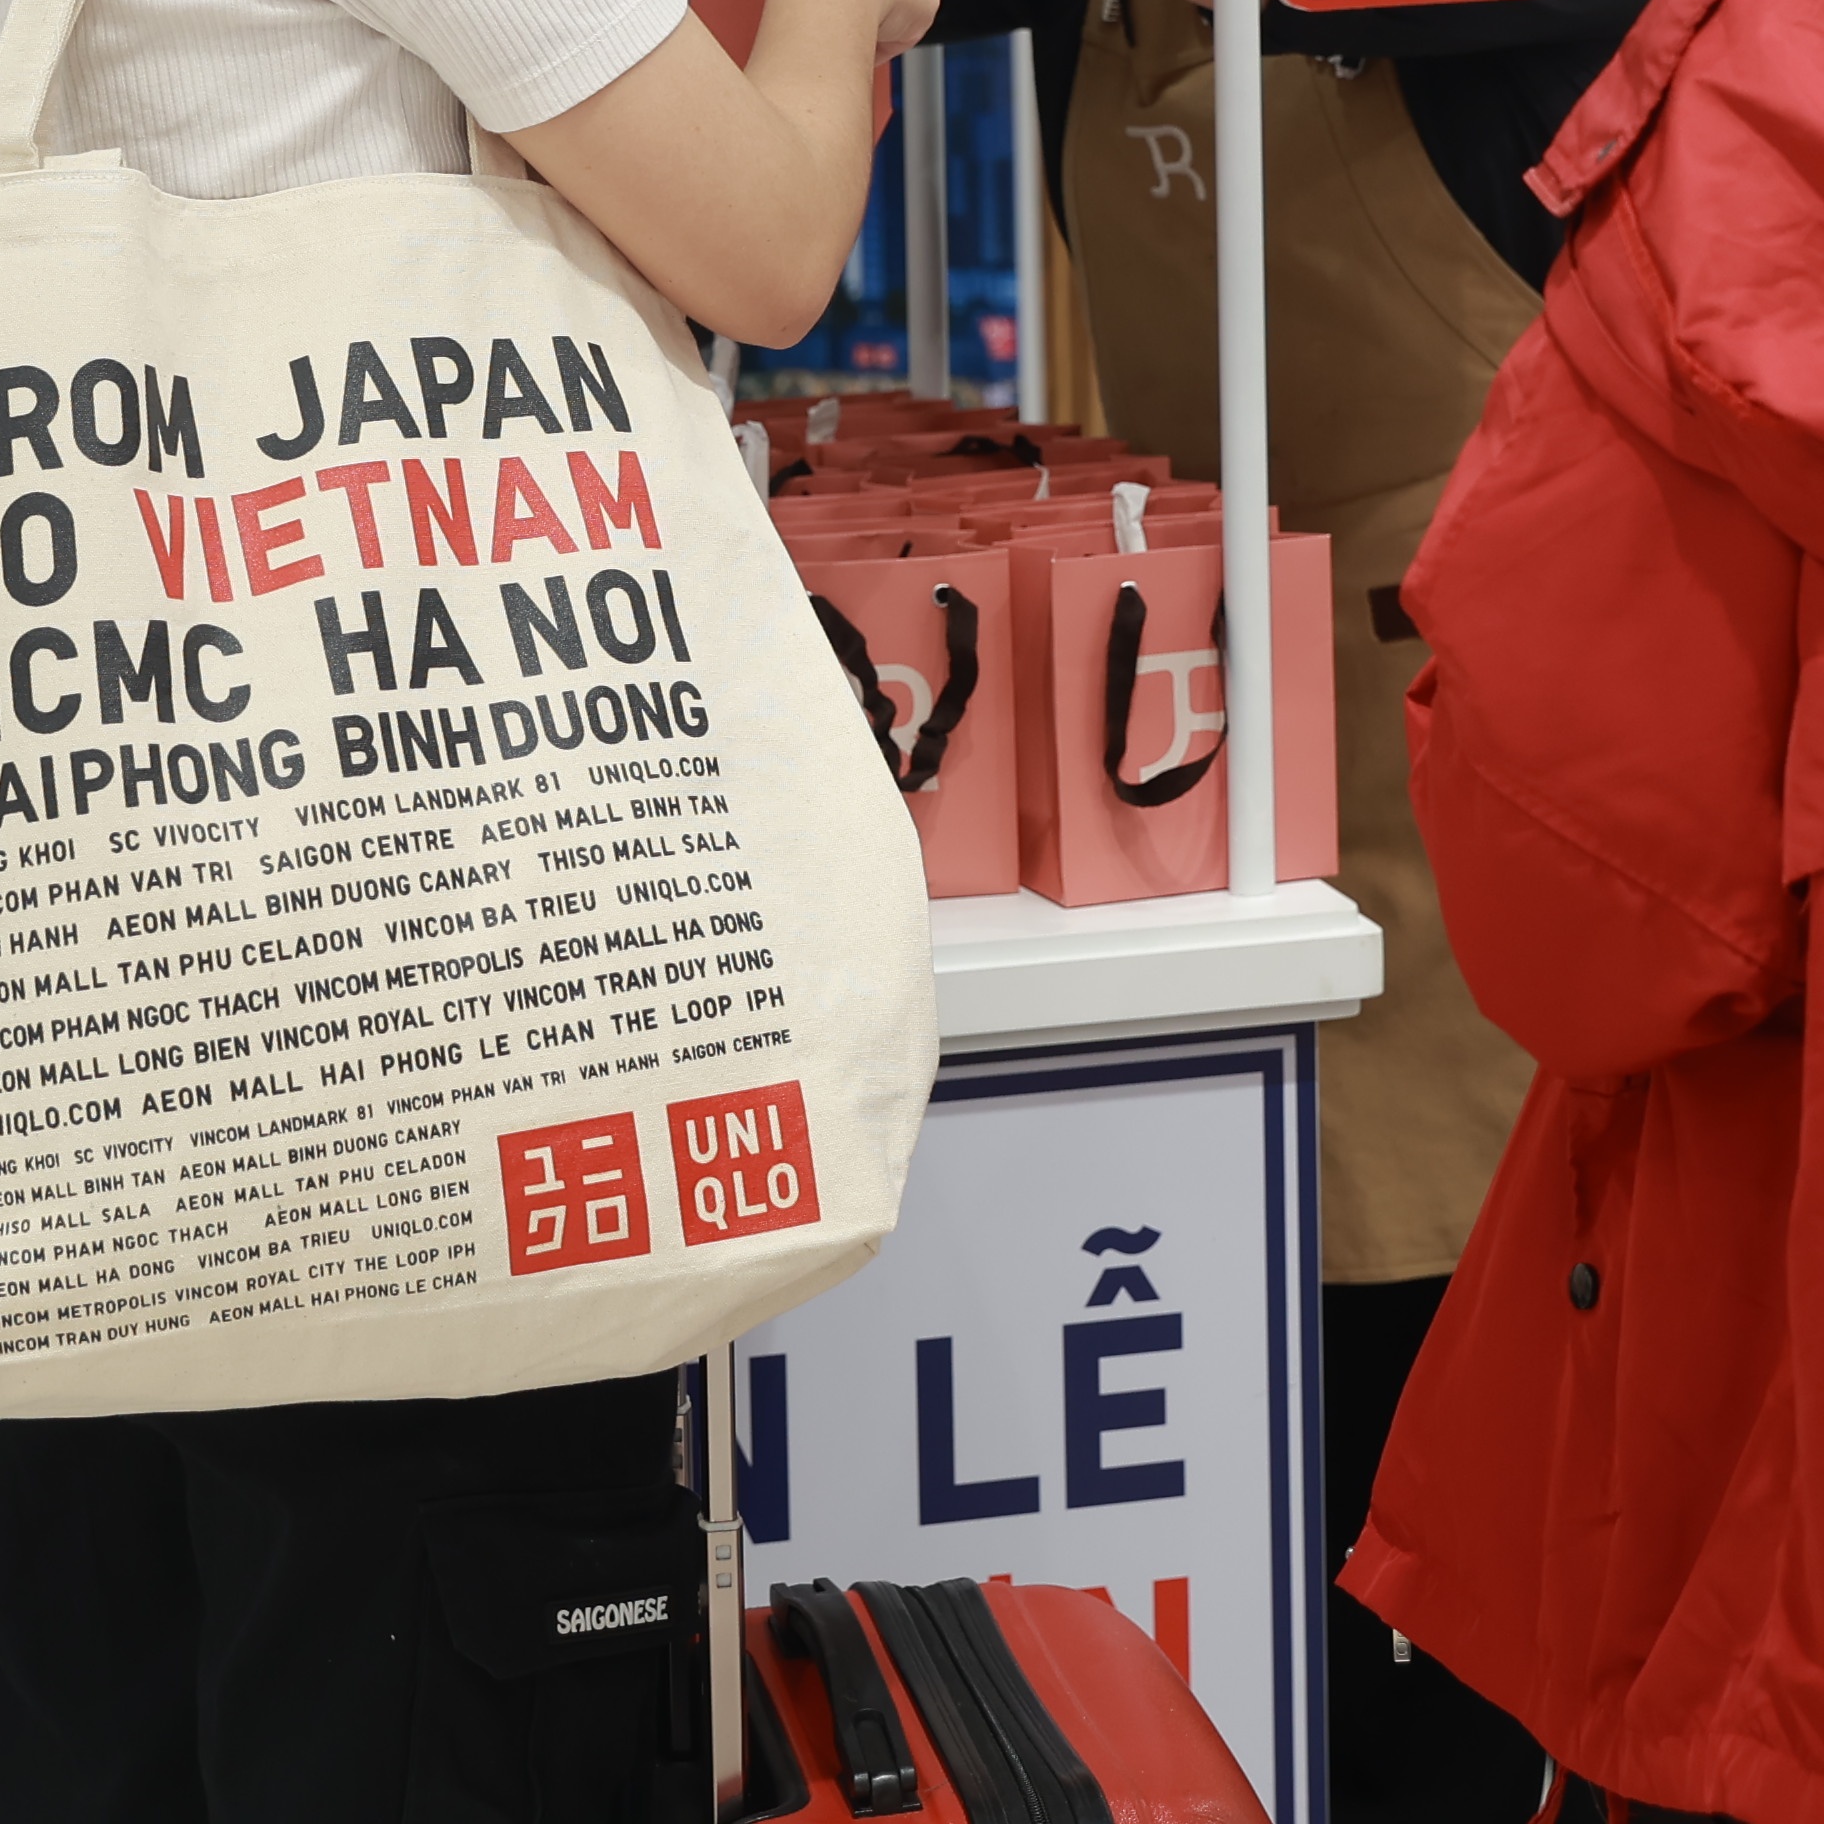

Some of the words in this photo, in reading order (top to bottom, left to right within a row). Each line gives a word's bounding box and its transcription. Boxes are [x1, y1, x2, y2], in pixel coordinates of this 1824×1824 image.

[255, 335, 632, 462] JAPAN
[132, 450, 663, 603] VIETNAM
[313, 587, 485, 696] HA
[499, 568, 692, 678] NOI
[331, 705, 487, 778] BINH
[488, 680, 710, 761] DUONG
[18, 838, 76, 869] KHOI
[108, 829, 141, 854] SC
[152, 816, 259, 848] VIVOCITY
[294, 794, 387, 827] VINCOM
[394, 777, 525, 814] LANDMARK
[534, 771, 561, 794] 81
[588, 756, 720, 786] UNIQLO.COM
[141, 1083, 212, 1116] AEON
[229, 1070, 304, 1102] MALL
[319, 1058, 365, 1087] HAI
[380, 1042, 463, 1077] PHONG
[479, 1033, 511, 1060] LE
[526, 1018, 595, 1051] CHAN
[609, 1007, 659, 1036] THE
[671, 994, 732, 1025] LOOP
[745, 985, 785, 1012] IPH
[685, 1104, 783, 1164] UNI
[694, 1162, 800, 1231] QLO
[209, 1304, 254, 1324] AEON
[259, 1295, 305, 1315] MALL
[310, 1289, 340, 1307] HAI
[344, 1283, 400, 1301] PHONG
[405, 1278, 427, 1295] LE
[432, 1269, 477, 1290] CHAN
[915, 1225, 1186, 1527] LỄ
[556, 1595, 669, 1635] SAIGONESE
